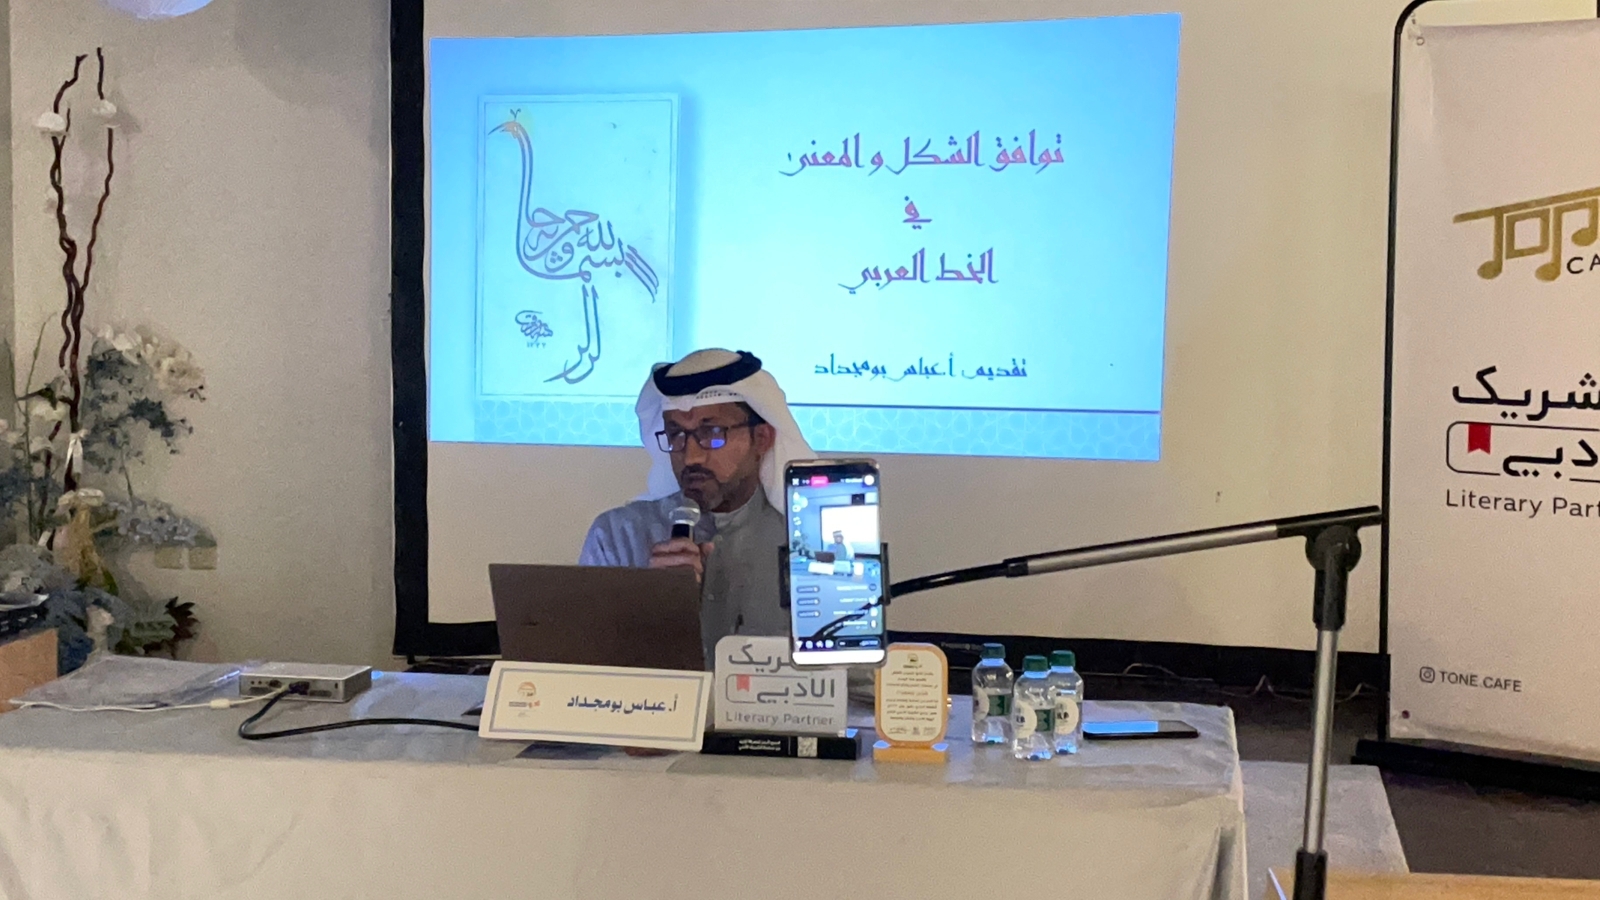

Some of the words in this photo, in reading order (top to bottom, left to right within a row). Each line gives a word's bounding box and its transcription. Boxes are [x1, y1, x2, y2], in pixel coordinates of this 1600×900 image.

[868, 151, 884, 176] و
[885, 130, 985, 175] الشكل
[989, 129, 1064, 174] توافق
[902, 195, 932, 230] في
[838, 247, 931, 294] العربي
[935, 247, 999, 285] الخط
[961, 358, 1028, 380] تقديم
[1446, 488, 1543, 519] Literary
[728, 643, 792, 673] ريك
[567, 695, 623, 713] بومجداد
[623, 697, 666, 715] عباس
[725, 711, 779, 726] Literary
[783, 713, 835, 726] Partner
